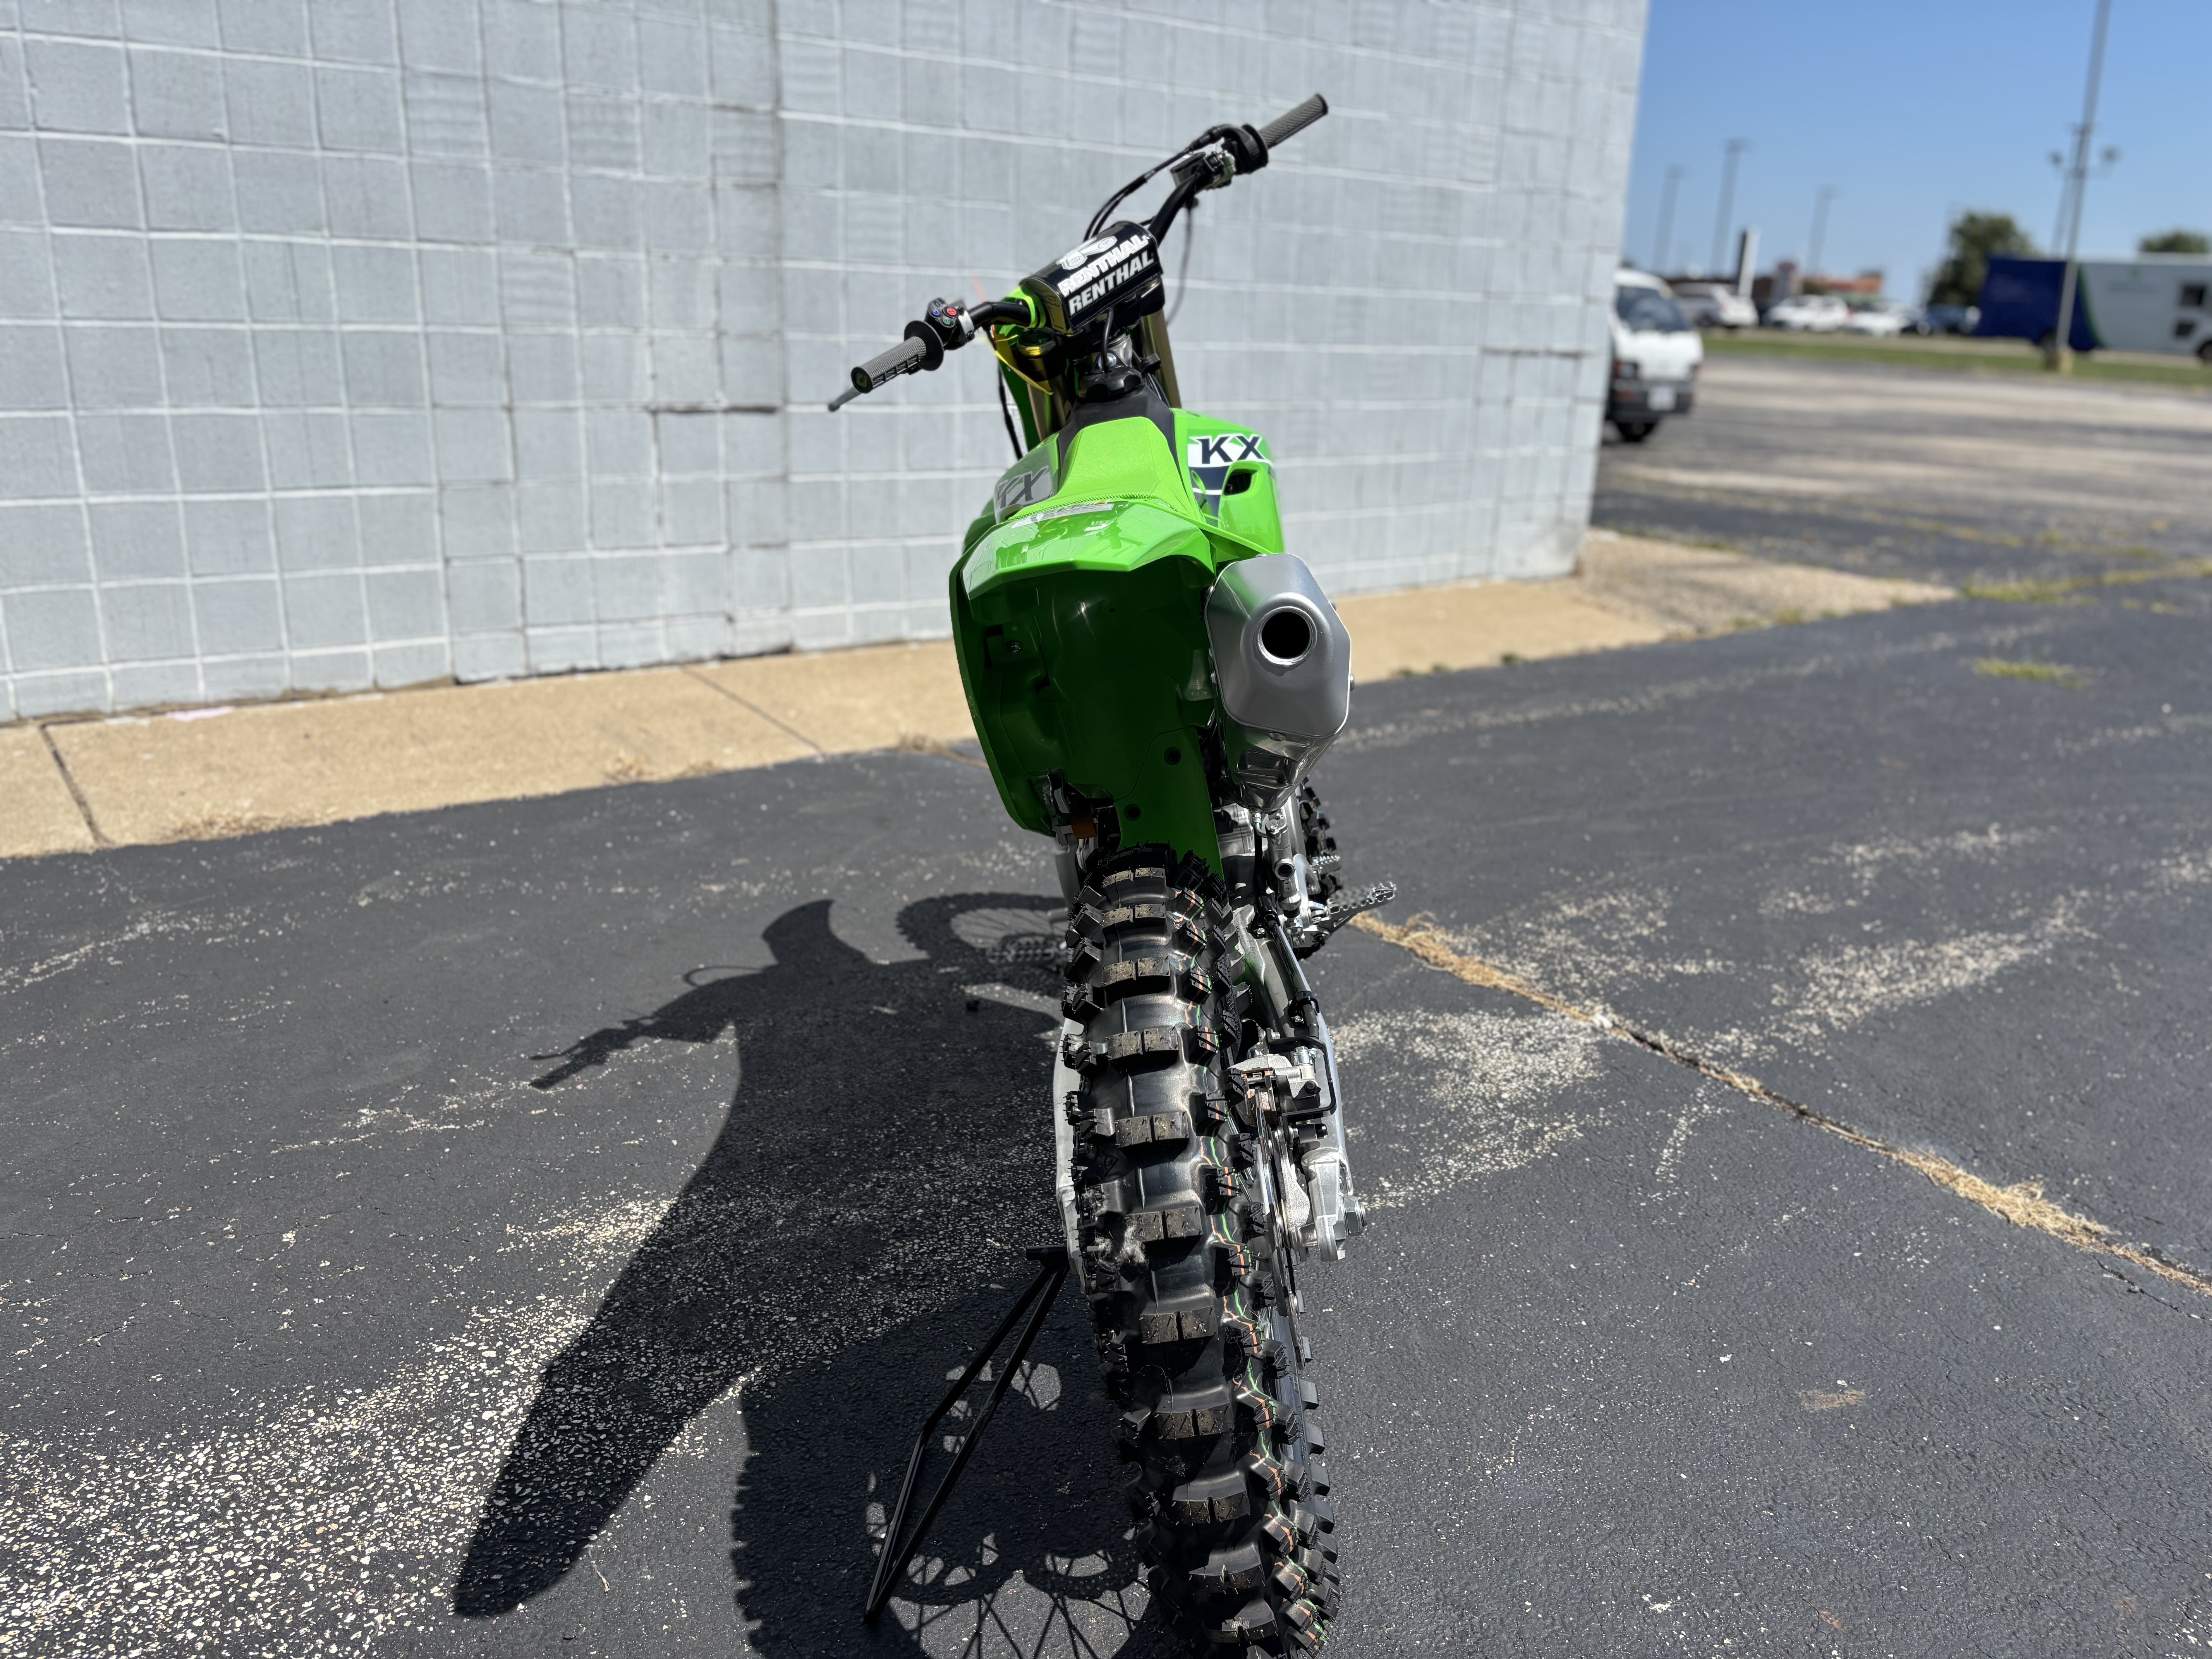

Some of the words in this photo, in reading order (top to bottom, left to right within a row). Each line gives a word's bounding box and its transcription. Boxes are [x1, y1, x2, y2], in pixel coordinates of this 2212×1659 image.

[1058, 234, 1149, 297] RENTHAL
[1068, 250, 1154, 316] RENTHAL
[1195, 434, 1266, 465] KX
